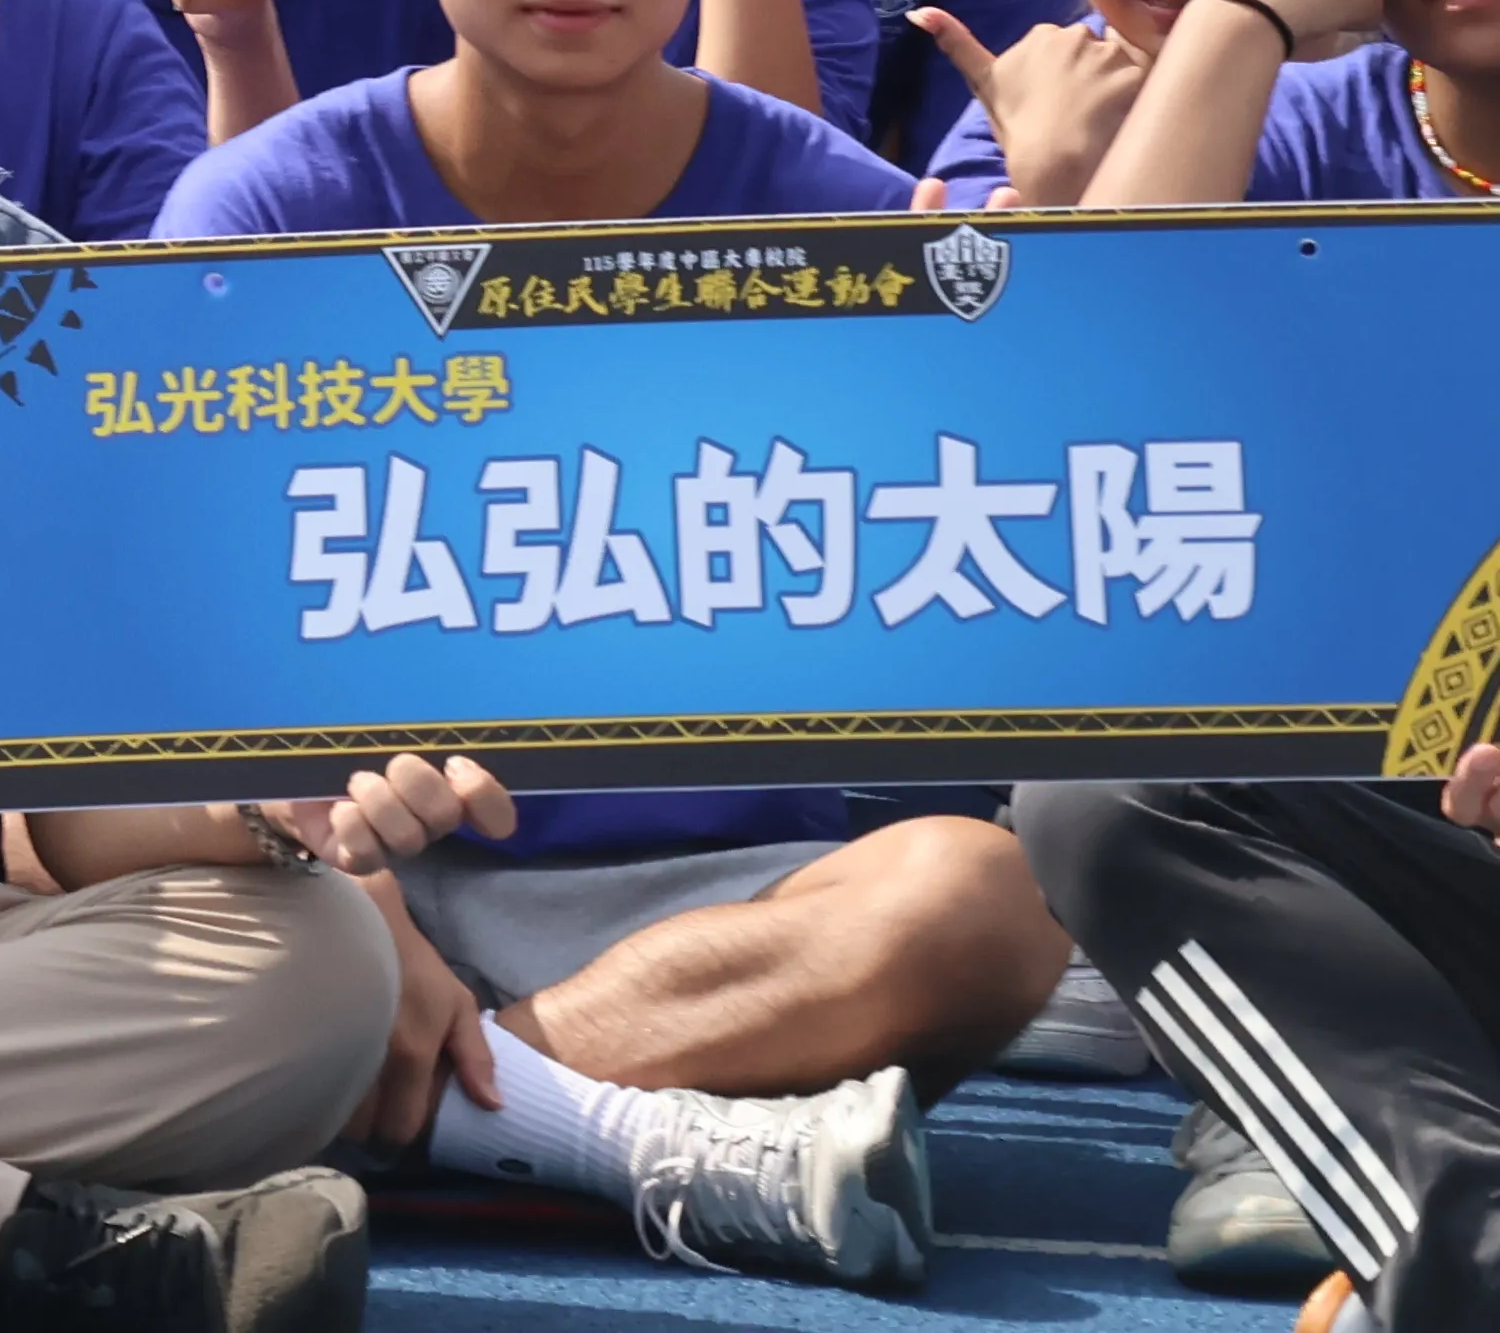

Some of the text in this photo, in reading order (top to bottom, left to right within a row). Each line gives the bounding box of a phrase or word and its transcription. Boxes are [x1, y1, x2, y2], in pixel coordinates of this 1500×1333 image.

[477, 264, 915, 318] 原住民學生聯合運動會
[88, 354, 510, 438] 弘光科技大學
[288, 436, 1262, 640] 弘弘的太陽
